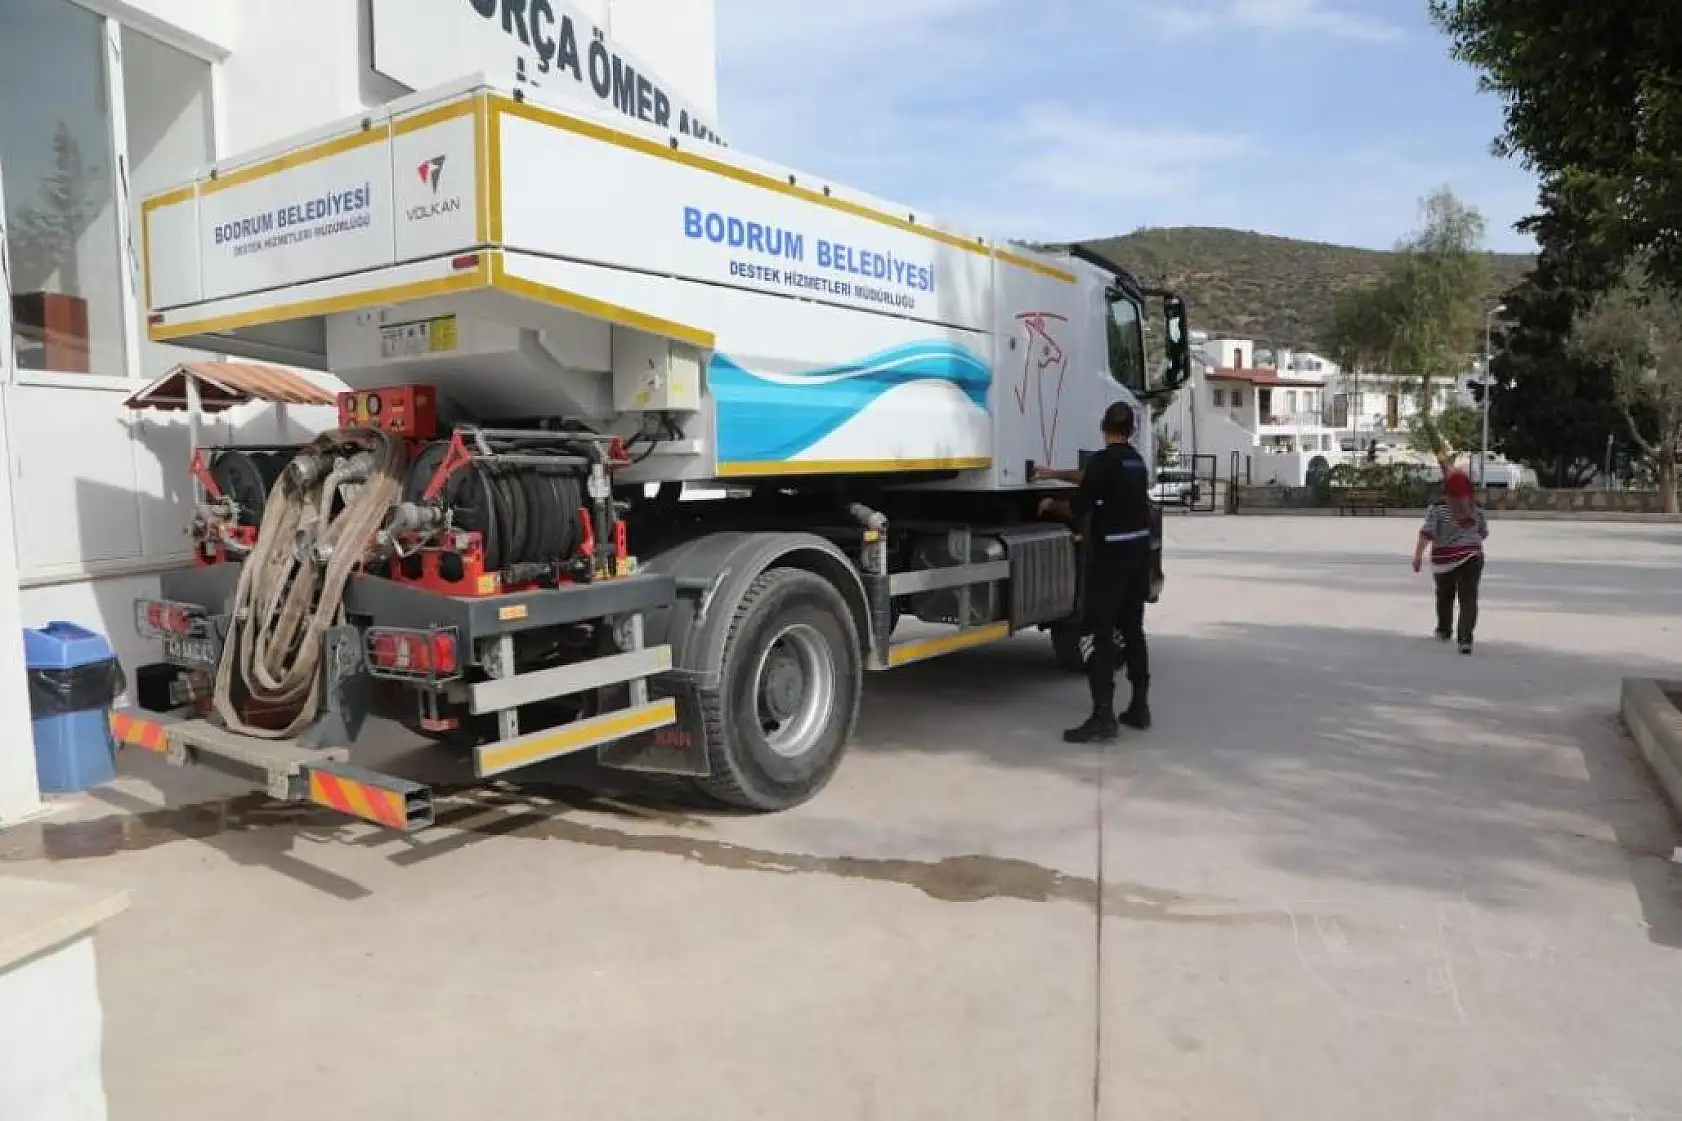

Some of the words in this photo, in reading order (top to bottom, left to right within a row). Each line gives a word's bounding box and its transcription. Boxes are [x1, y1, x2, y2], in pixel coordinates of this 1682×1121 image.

[587, 25, 671, 128] ÖMER
[214, 210, 274, 244] BODRUM
[277, 181, 371, 228] BELEDİYESİ
[406, 195, 460, 222] VOLKAN
[683, 205, 804, 262] BODRUM
[816, 238, 935, 293] BELEDİYESİ
[729, 260, 781, 284] DESTEK
[783, 268, 851, 297] HİZMETLERİ
